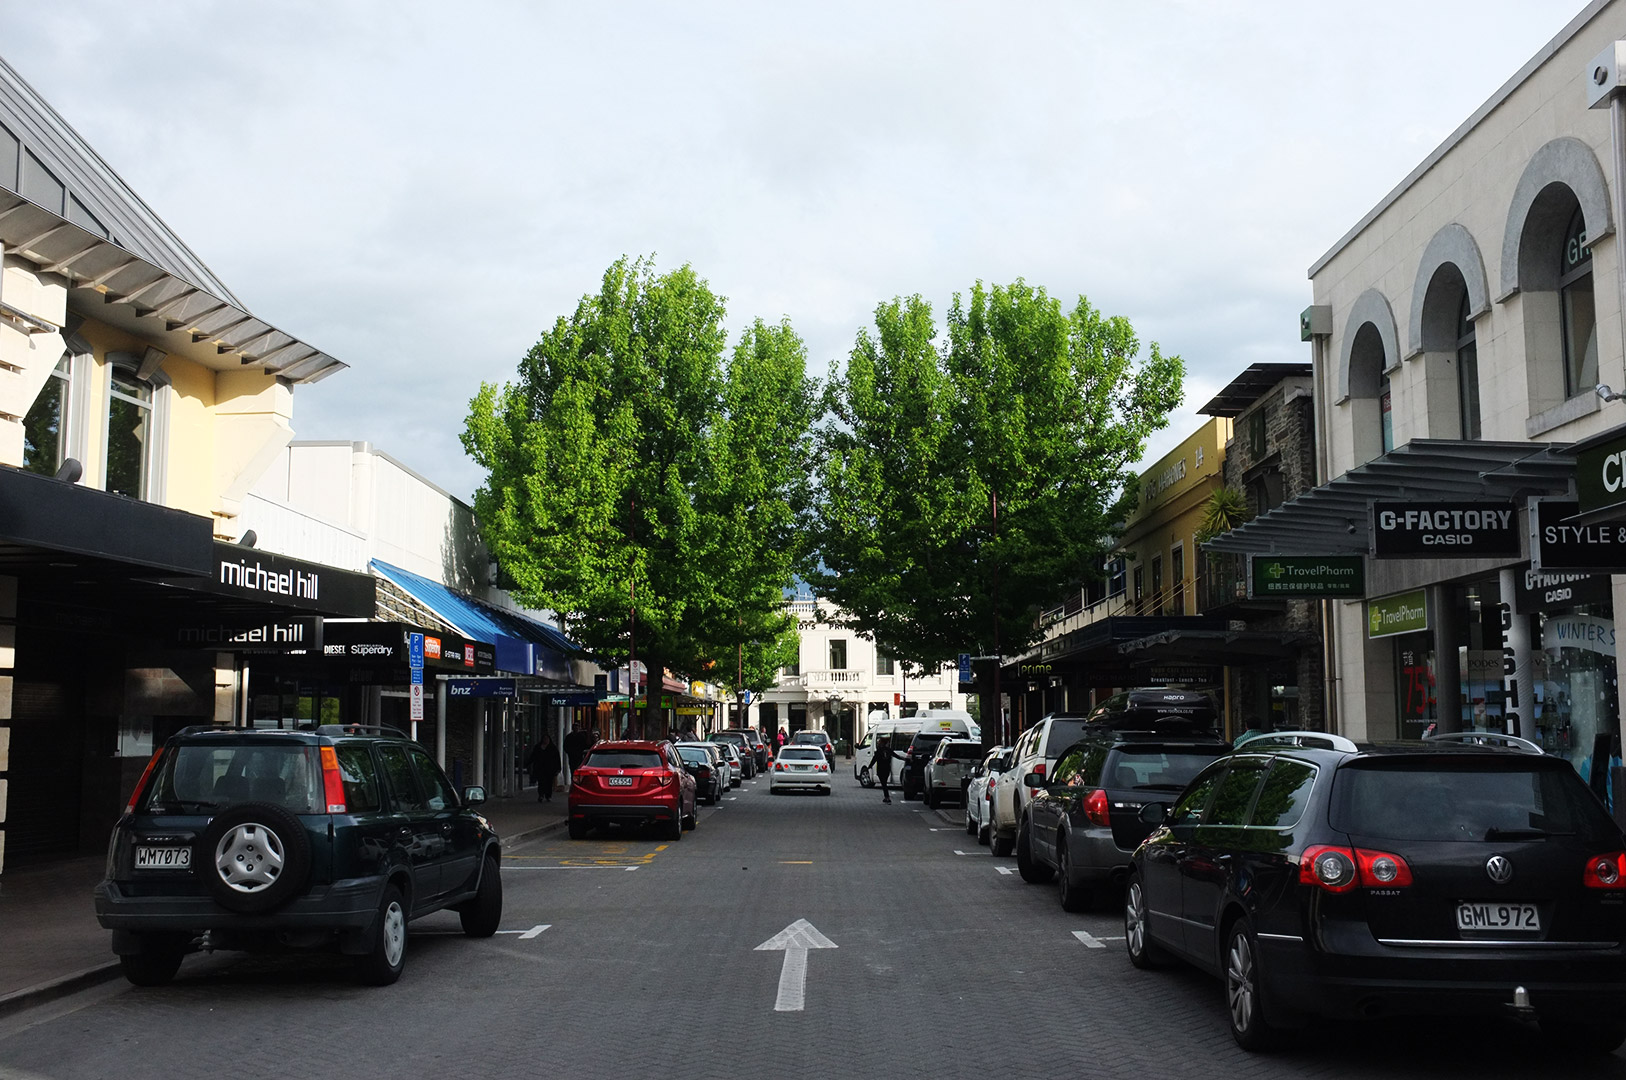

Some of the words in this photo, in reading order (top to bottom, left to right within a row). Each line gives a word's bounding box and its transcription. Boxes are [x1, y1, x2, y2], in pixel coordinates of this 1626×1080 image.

[1602, 450, 1626, 493] C
[1380, 510, 1512, 531] G-FACTORY
[1422, 534, 1473, 545] CASIO
[1545, 526, 1611, 544] STYLE
[1286, 565, 1354, 576] TravelPharm
[220, 558, 294, 596] michael
[296, 570, 319, 600] hill
[1545, 588, 1573, 603] CASIO
[1381, 605, 1425, 625] TravelPharm
[273, 624, 303, 642] hill
[324, 645, 346, 655] DIESEL
[1021, 664, 1052, 675] prime
[450, 684, 471, 695] bnz
[551, 697, 567, 706] bnz
[1459, 906, 1537, 927] GML972
